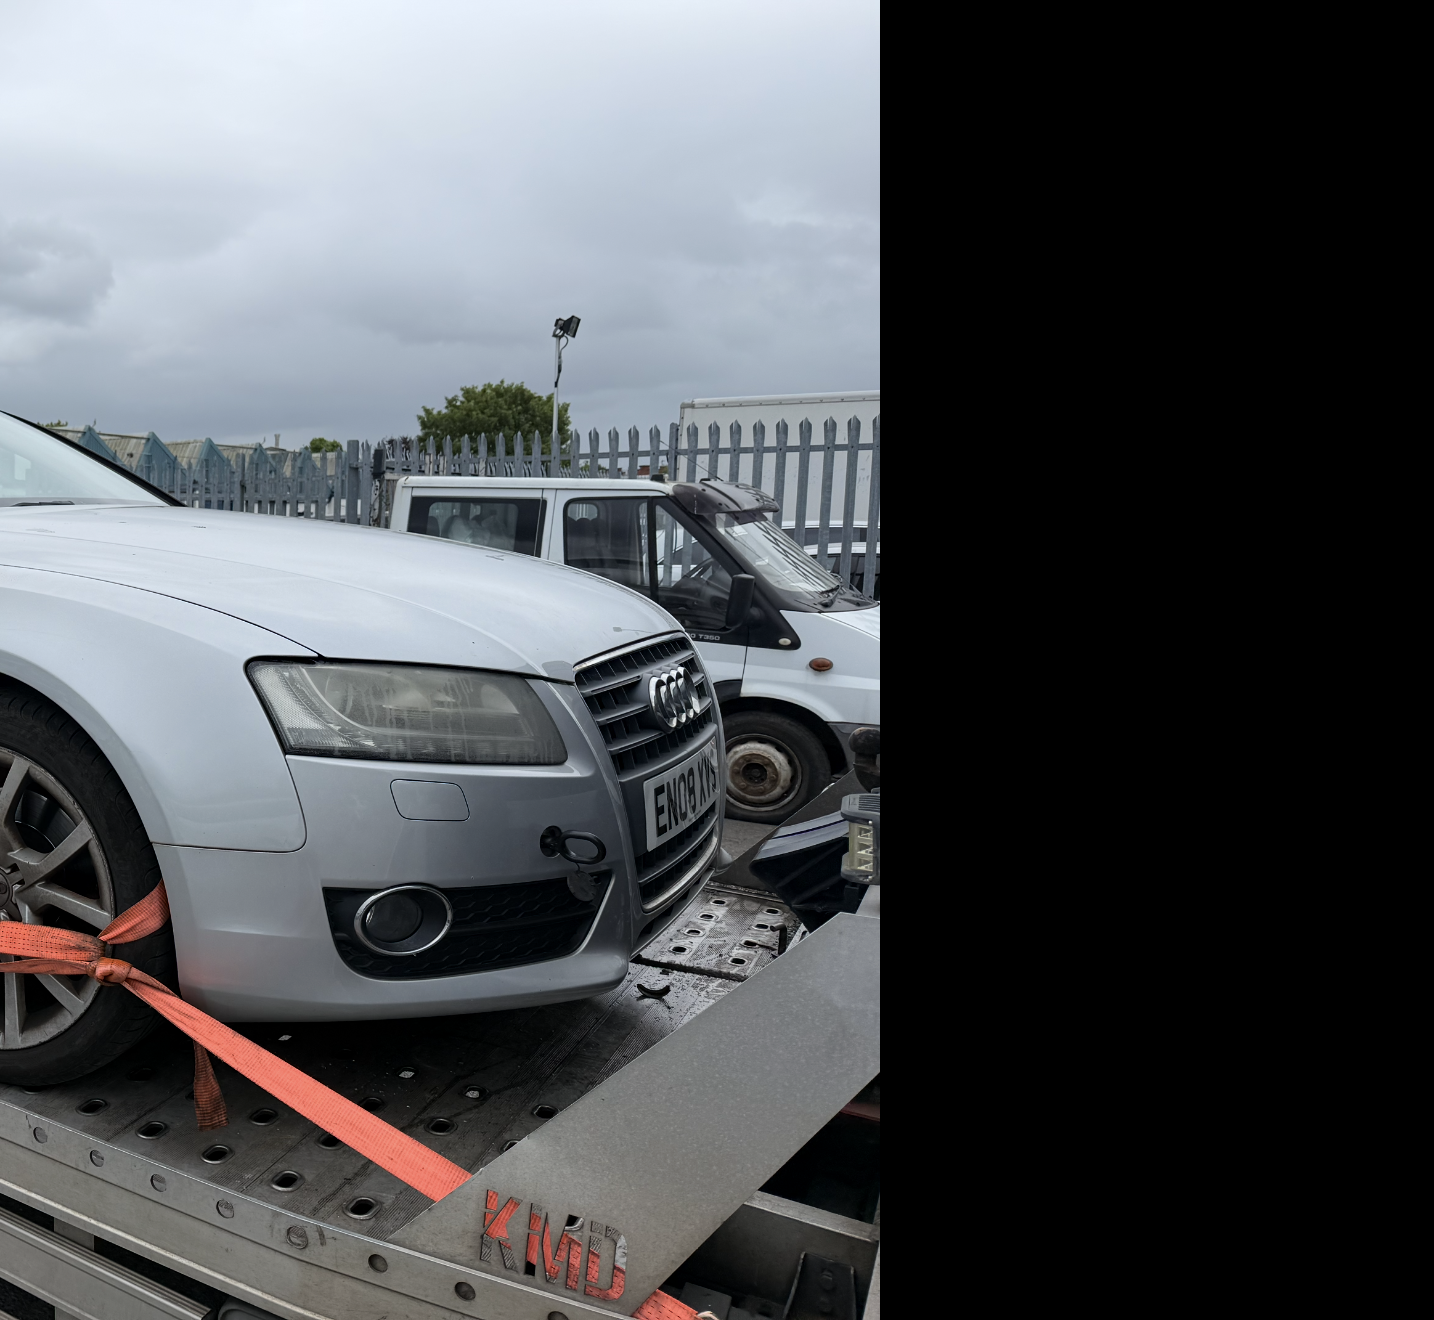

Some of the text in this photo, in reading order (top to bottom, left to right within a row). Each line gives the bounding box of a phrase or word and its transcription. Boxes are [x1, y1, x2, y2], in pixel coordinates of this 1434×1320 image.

[698, 633, 721, 641] T350
[654, 767, 696, 838] EN08
[480, 1189, 628, 1301] KMD
